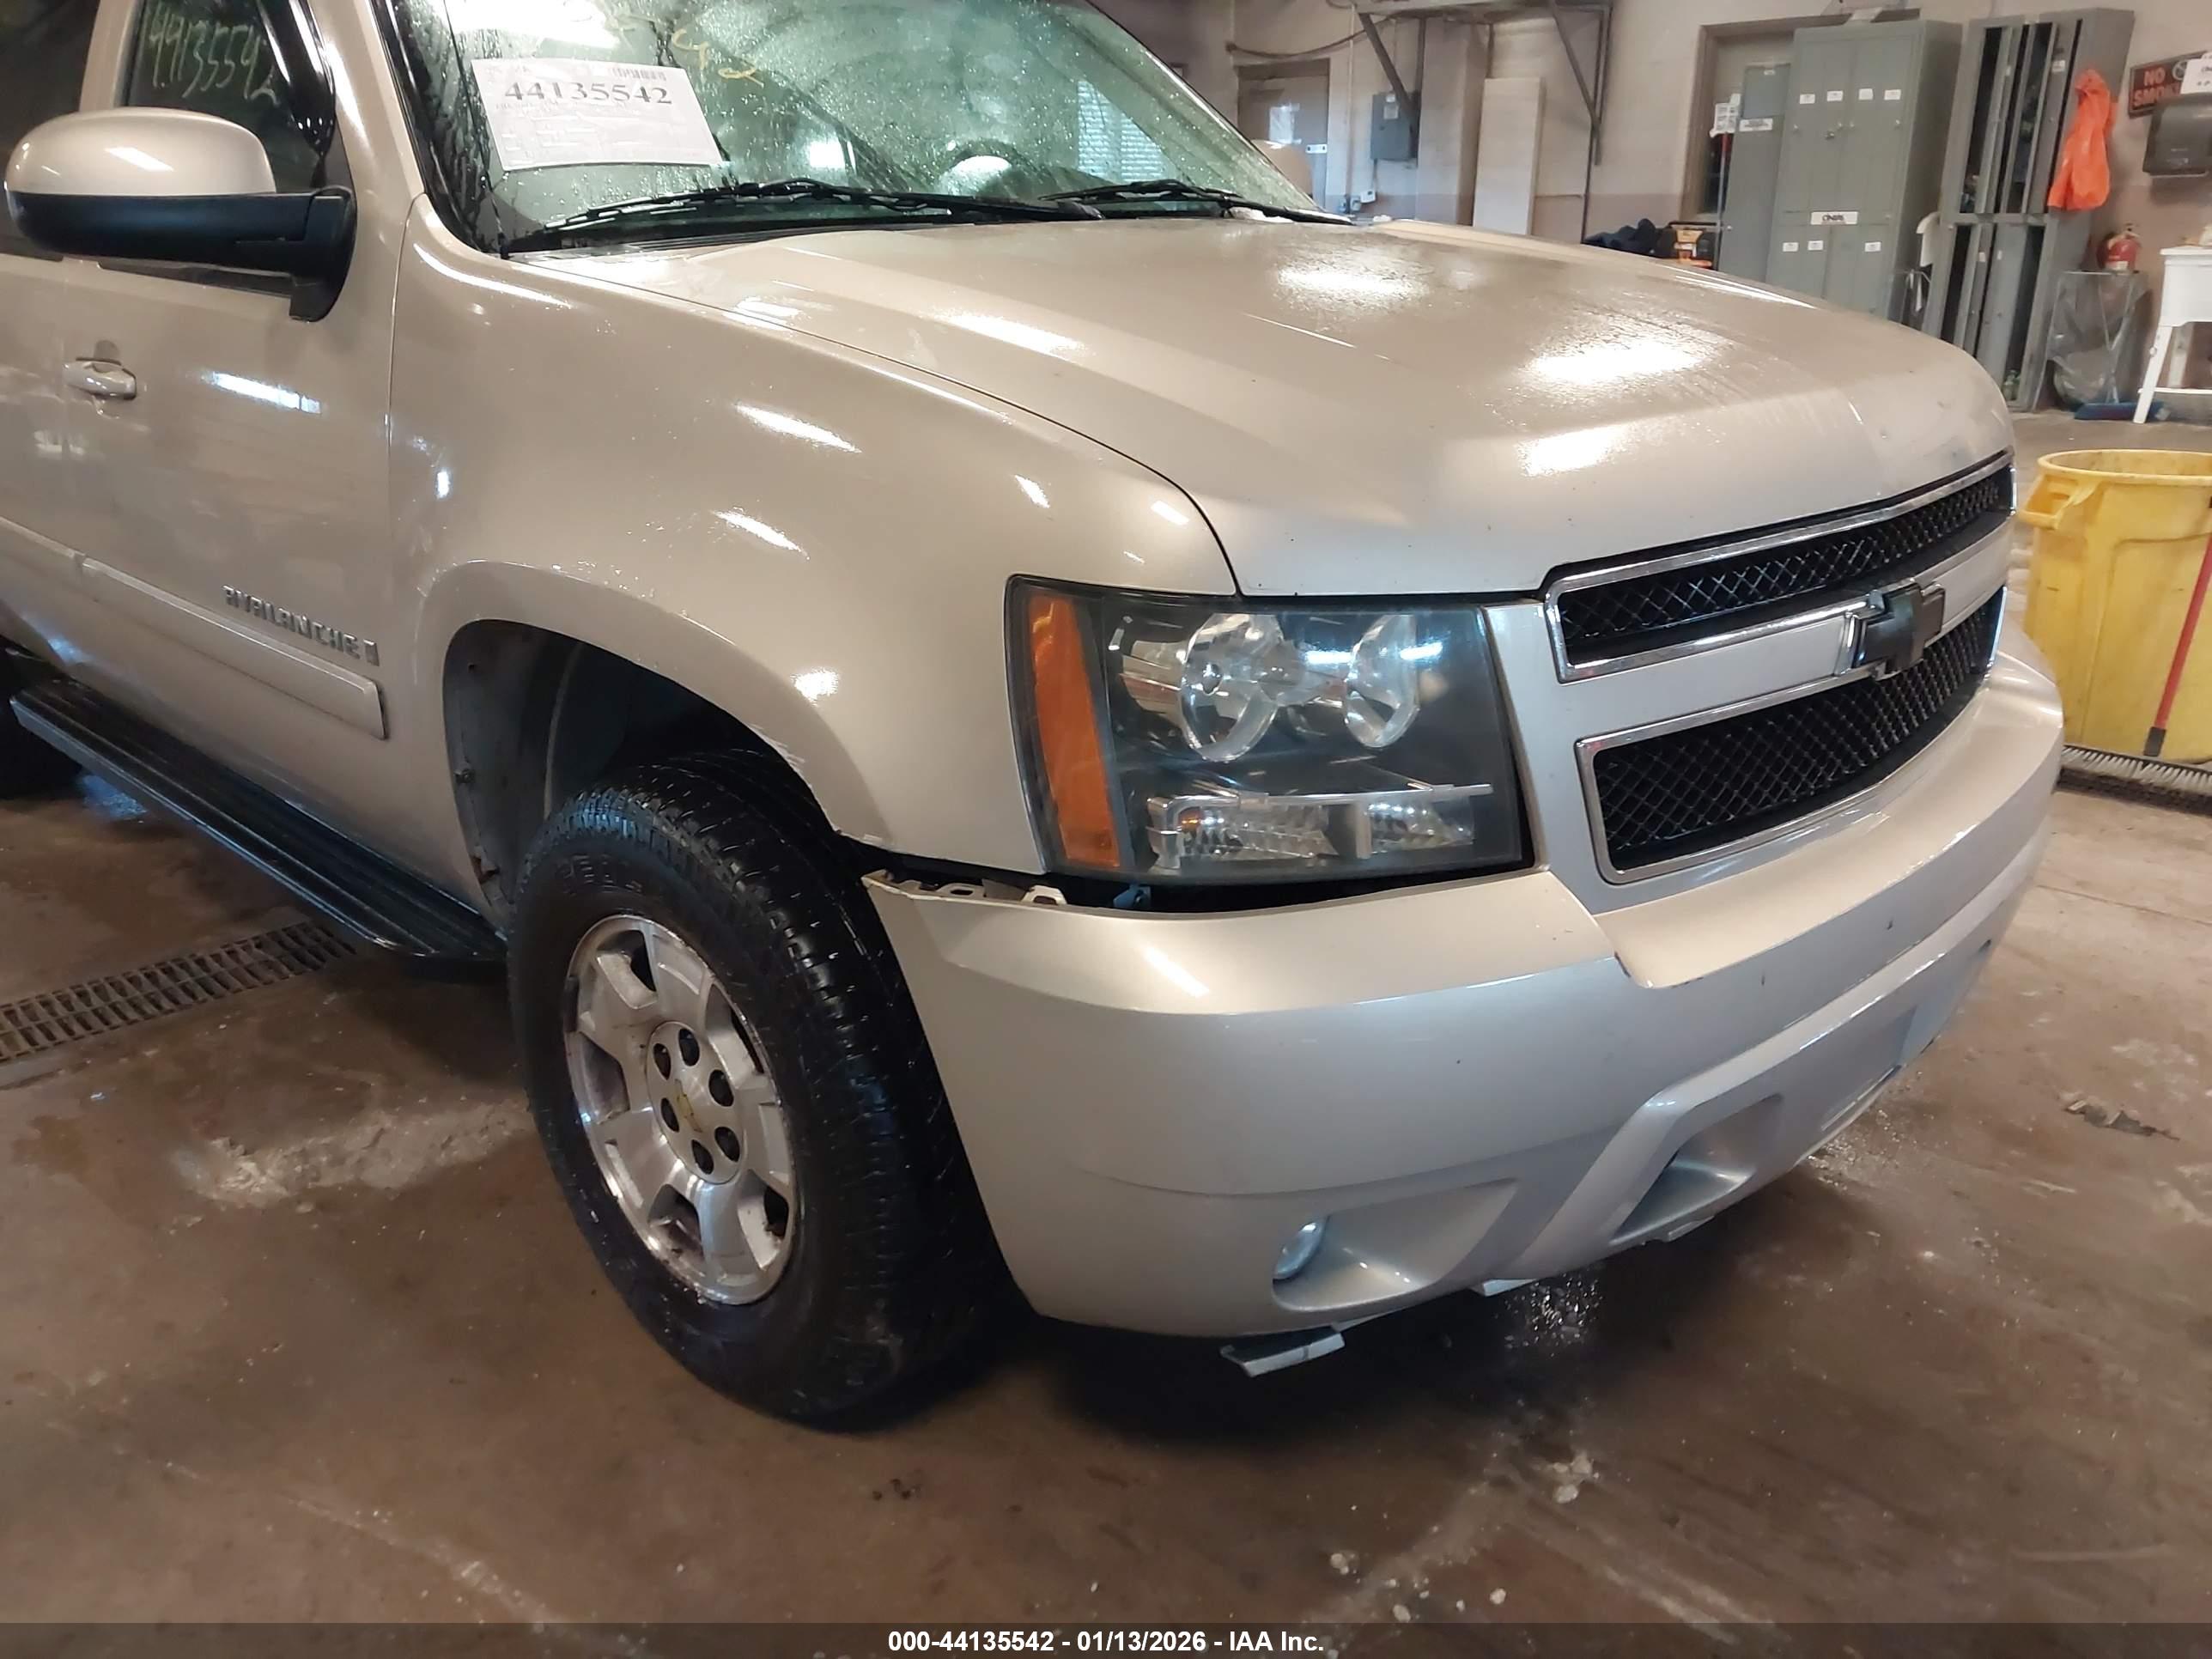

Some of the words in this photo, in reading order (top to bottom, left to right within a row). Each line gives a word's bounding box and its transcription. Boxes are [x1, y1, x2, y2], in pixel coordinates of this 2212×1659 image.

[2143, 66, 2166, 87] NO
[504, 82, 672, 104] 44135542
[222, 585, 361, 659] AVALANCHE
